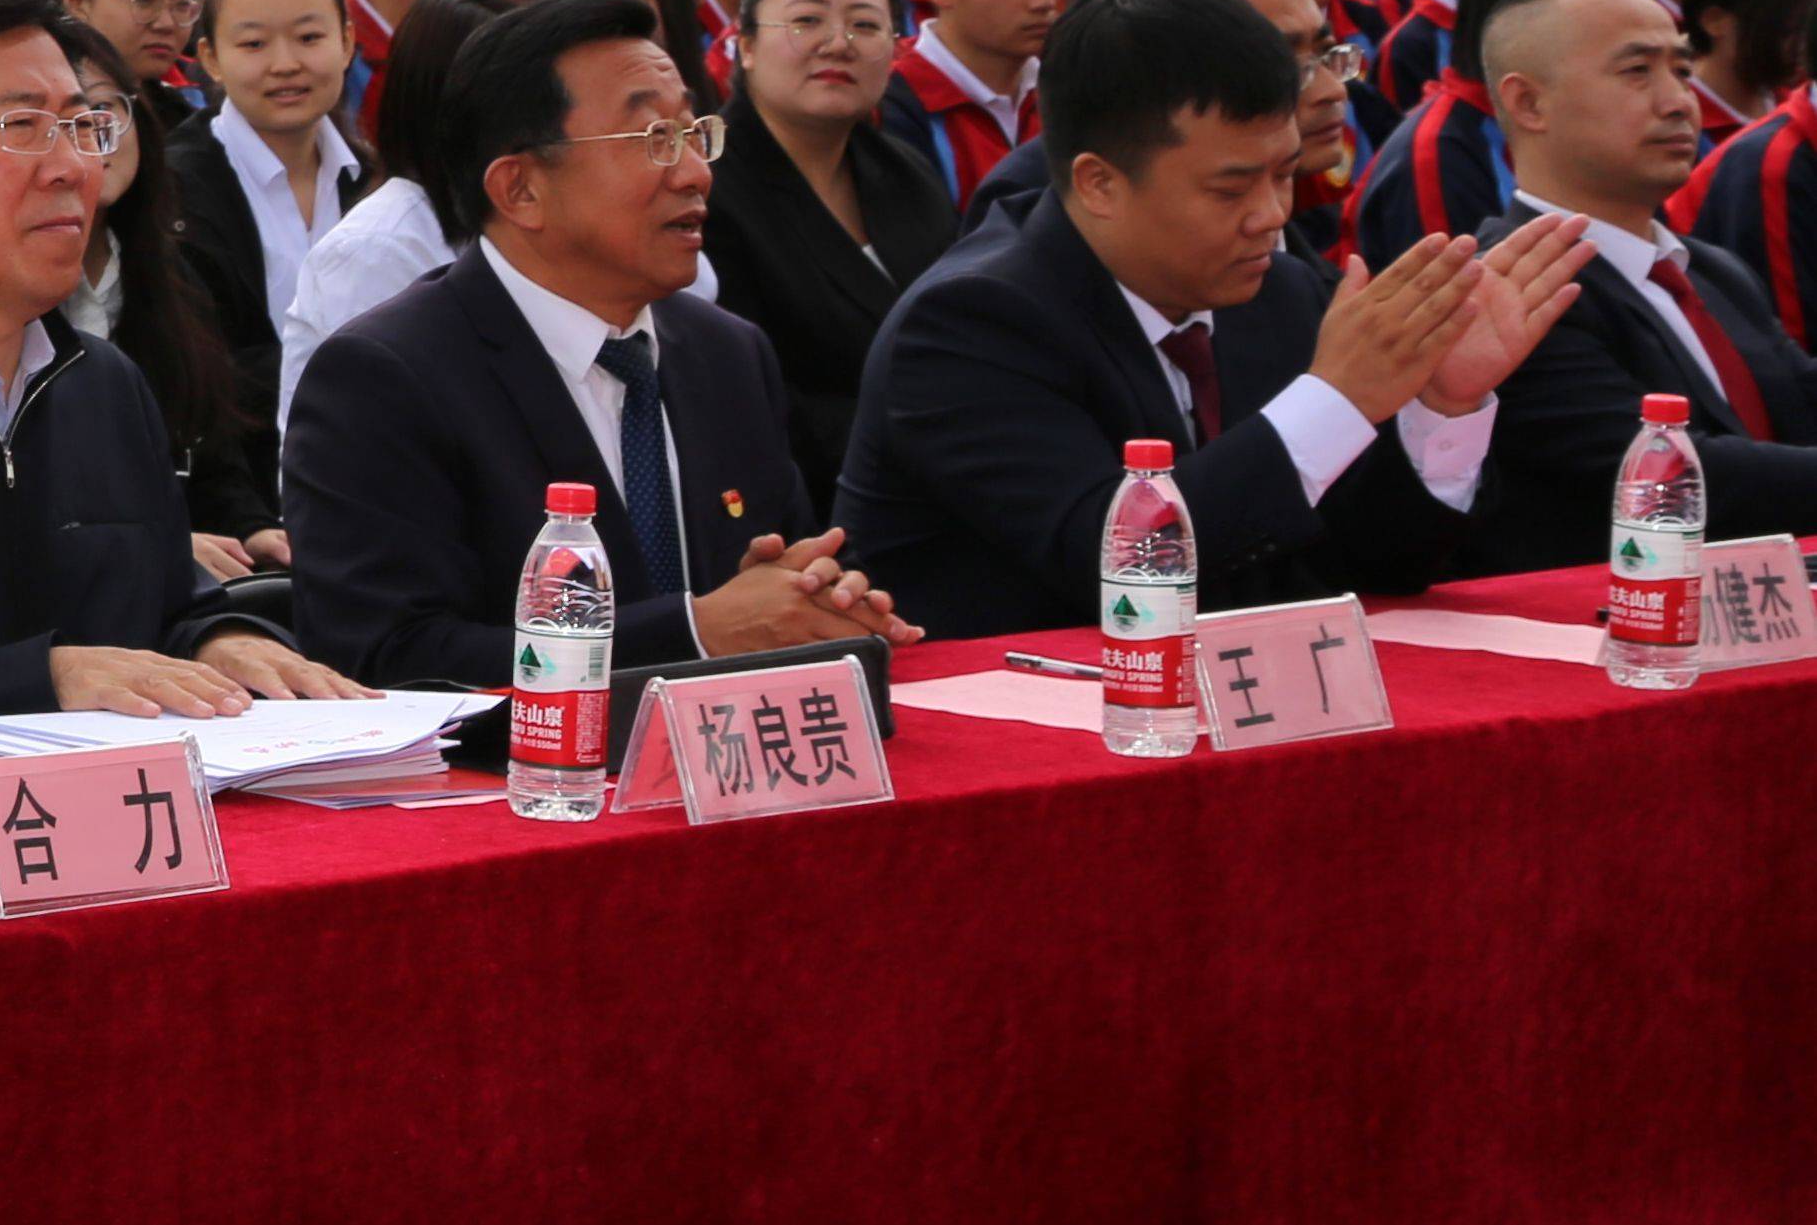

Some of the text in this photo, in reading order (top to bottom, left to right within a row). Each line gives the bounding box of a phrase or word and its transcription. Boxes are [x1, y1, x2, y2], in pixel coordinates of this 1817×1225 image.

[512, 698, 563, 727] 夫山泉
[1218, 646, 1275, 728] 王
[698, 687, 856, 797] 杨良贵
